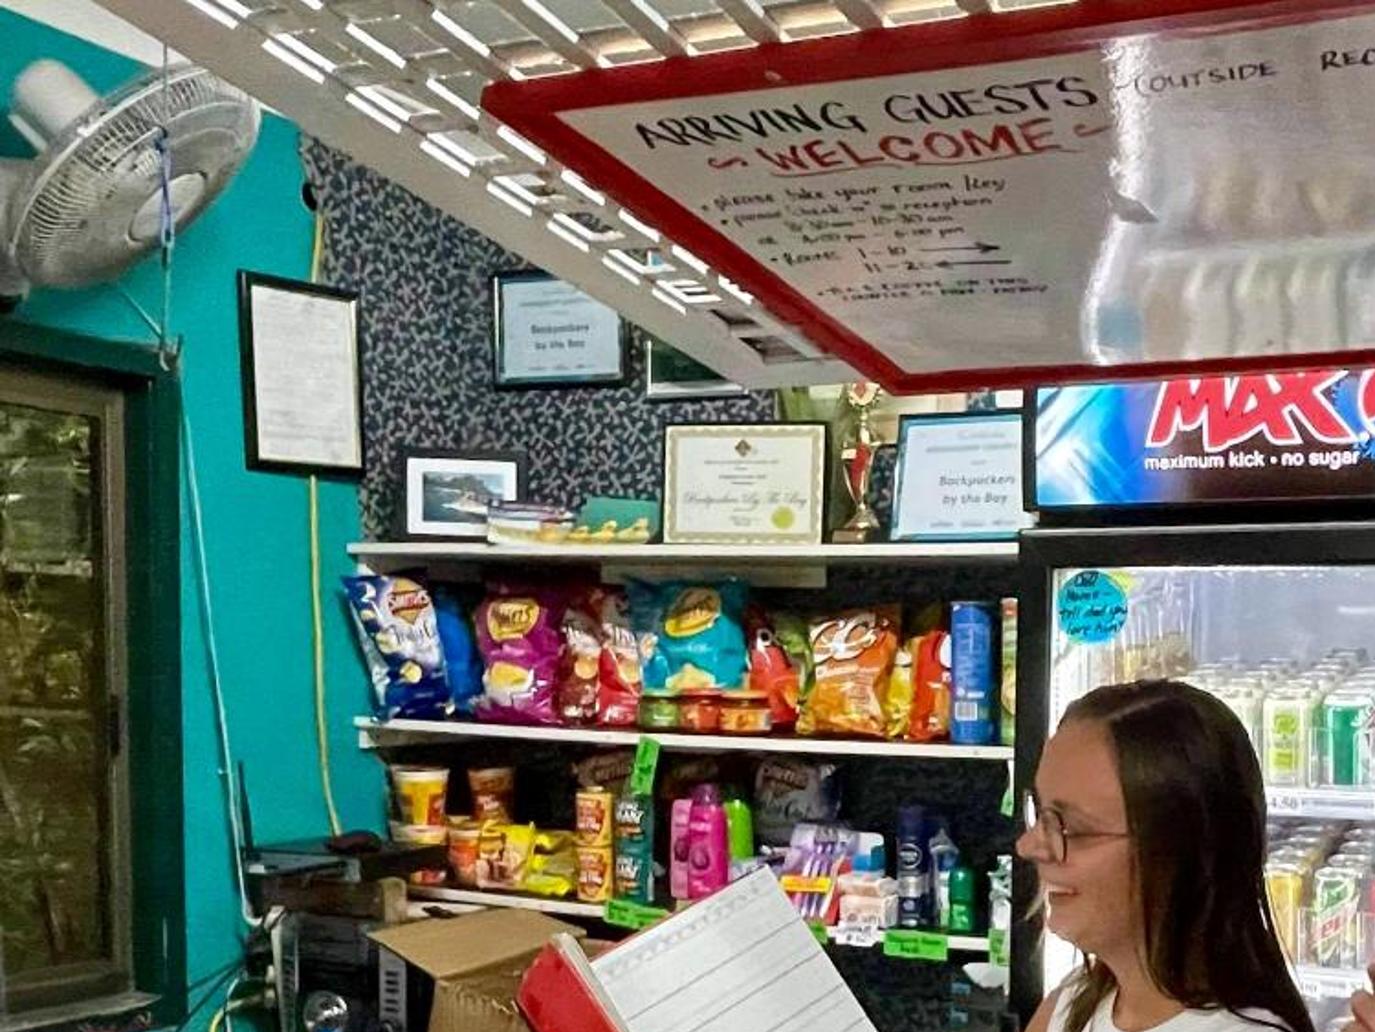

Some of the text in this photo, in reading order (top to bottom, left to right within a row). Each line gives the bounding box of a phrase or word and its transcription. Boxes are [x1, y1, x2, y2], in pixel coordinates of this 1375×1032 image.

[634, 76, 1099, 150] ARRIVING GUESTS
[755, 117, 1063, 171] WELCOME
[834, 185, 878, 202] your
[1145, 369, 1358, 452] MAX
[1144, 450, 1361, 471] maximum kick no sugar
